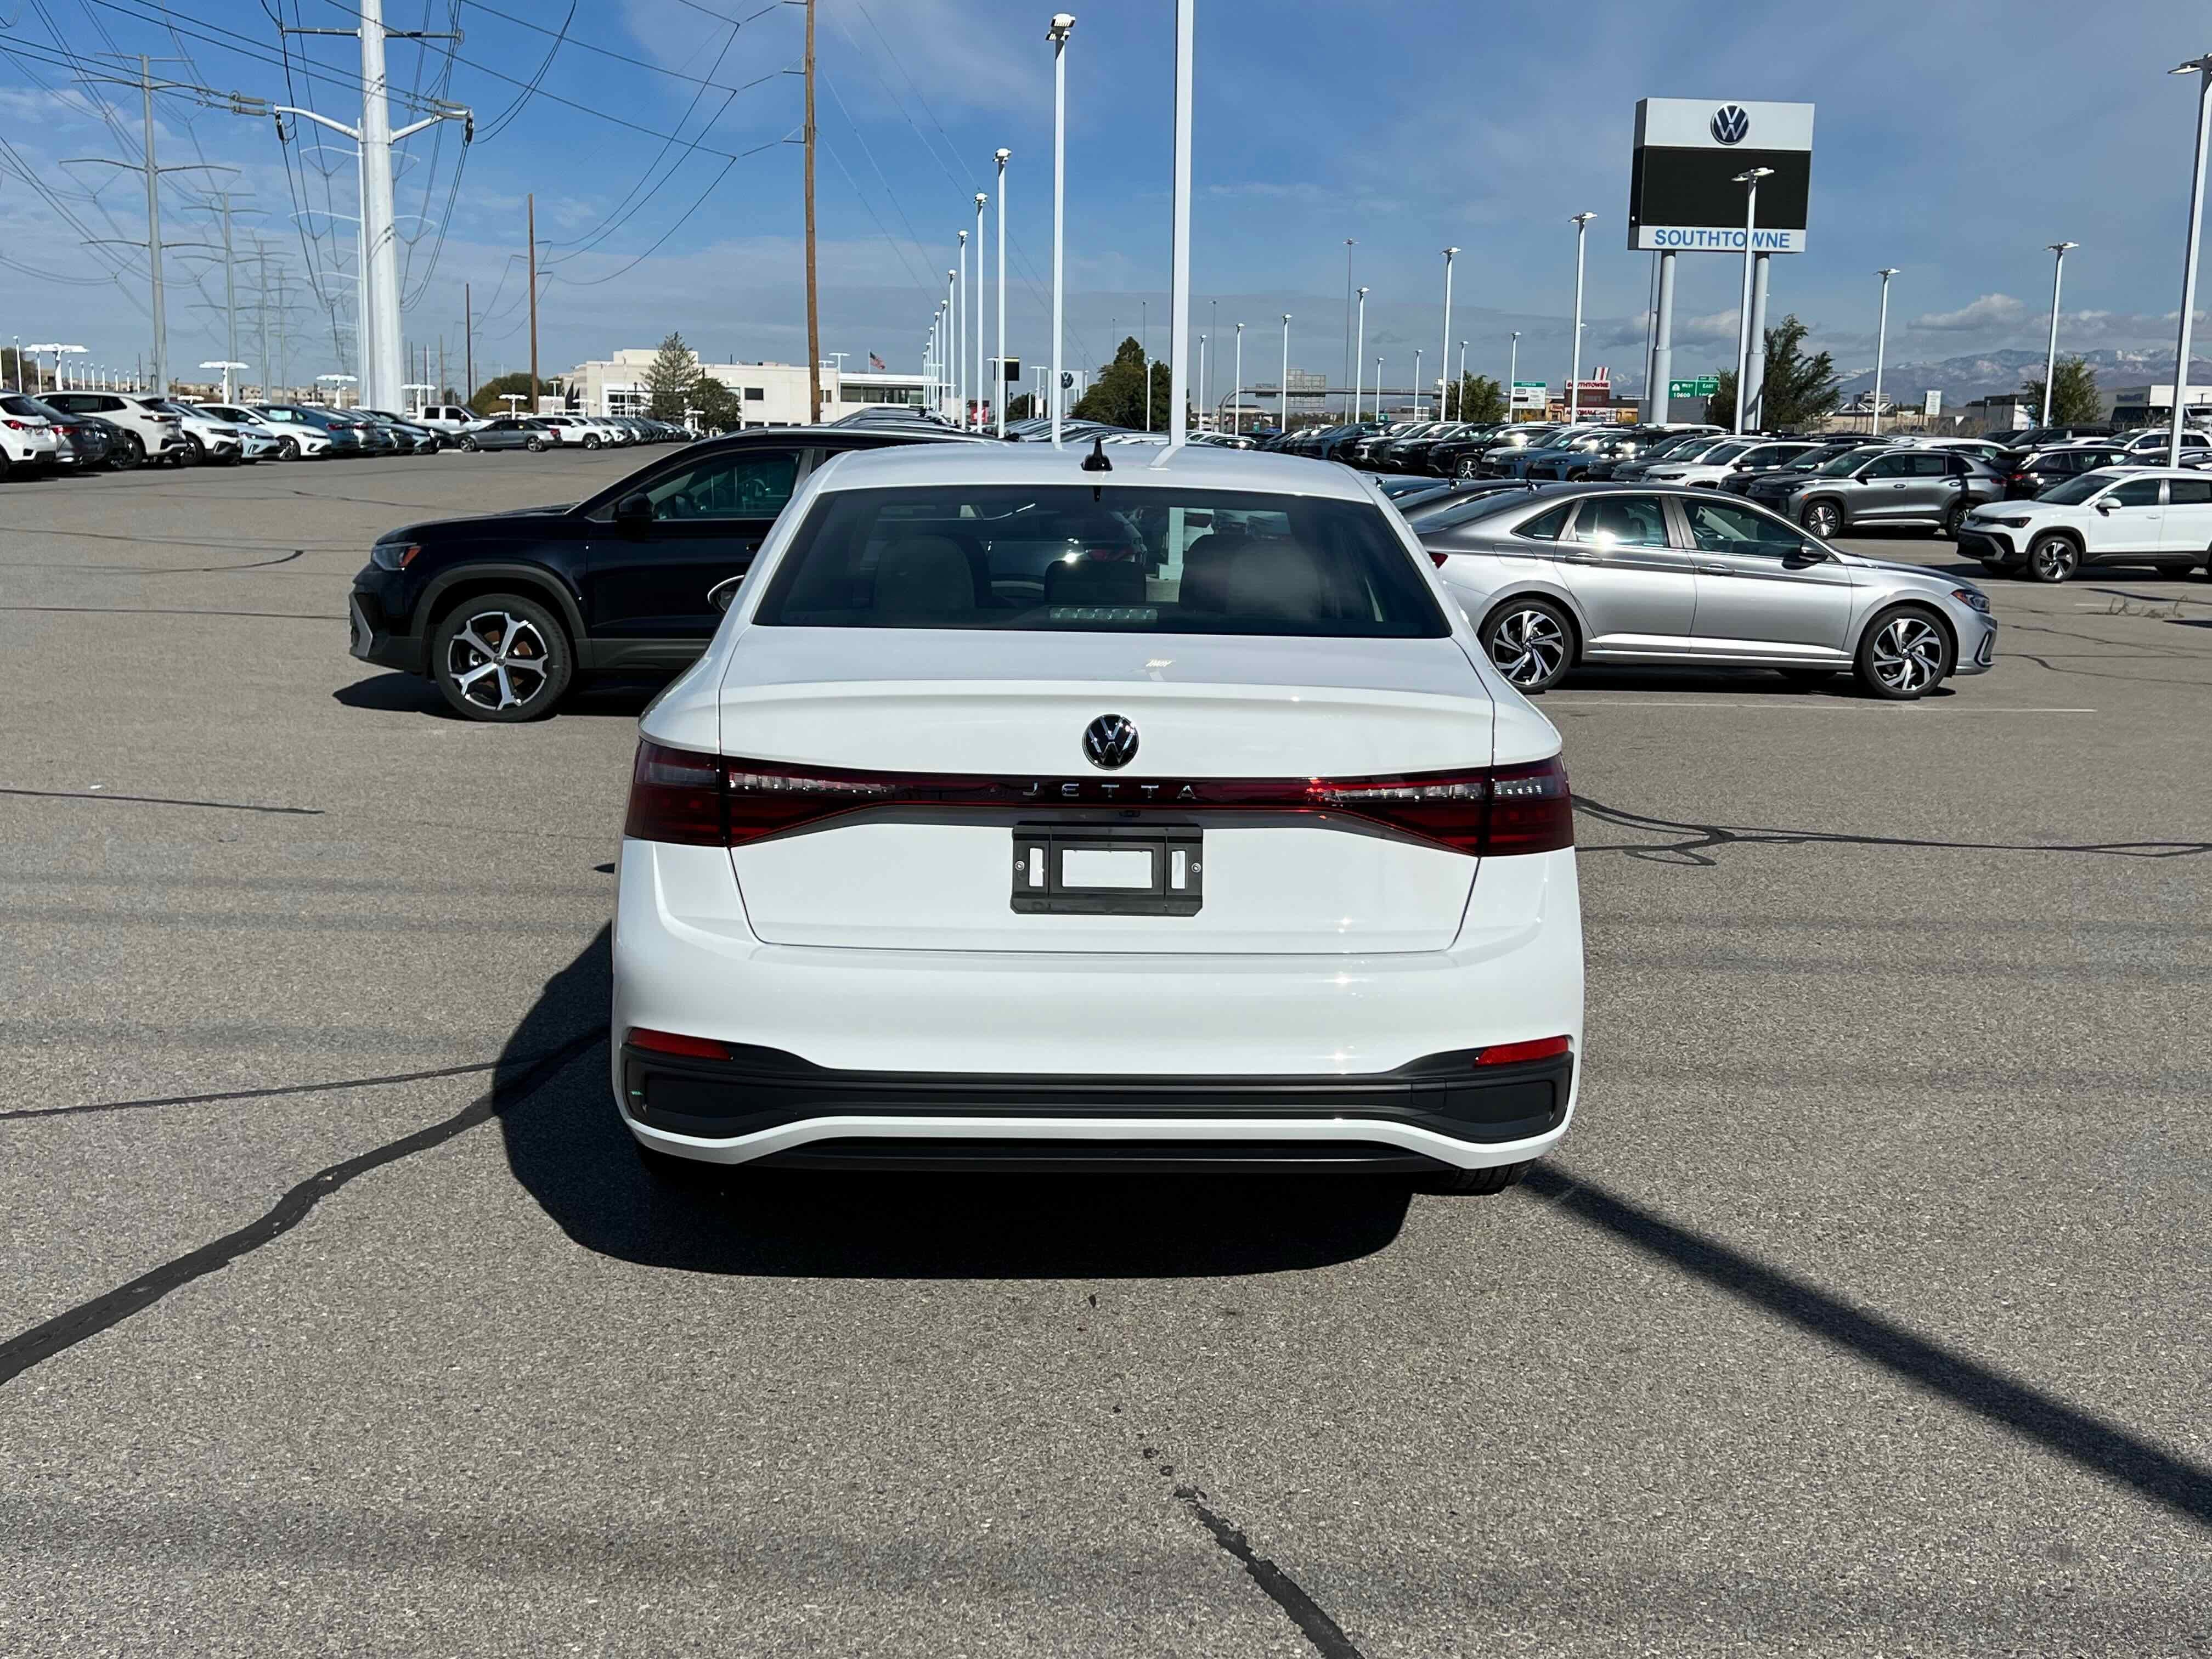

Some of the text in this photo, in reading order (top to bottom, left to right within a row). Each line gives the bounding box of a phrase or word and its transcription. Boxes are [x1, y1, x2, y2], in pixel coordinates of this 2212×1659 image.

[1712, 105, 1749, 144] VW
[1655, 229, 1790, 248] SOUTHTOWNE
[1082, 714, 1139, 770] VW
[1023, 782, 1197, 799] JETTA
